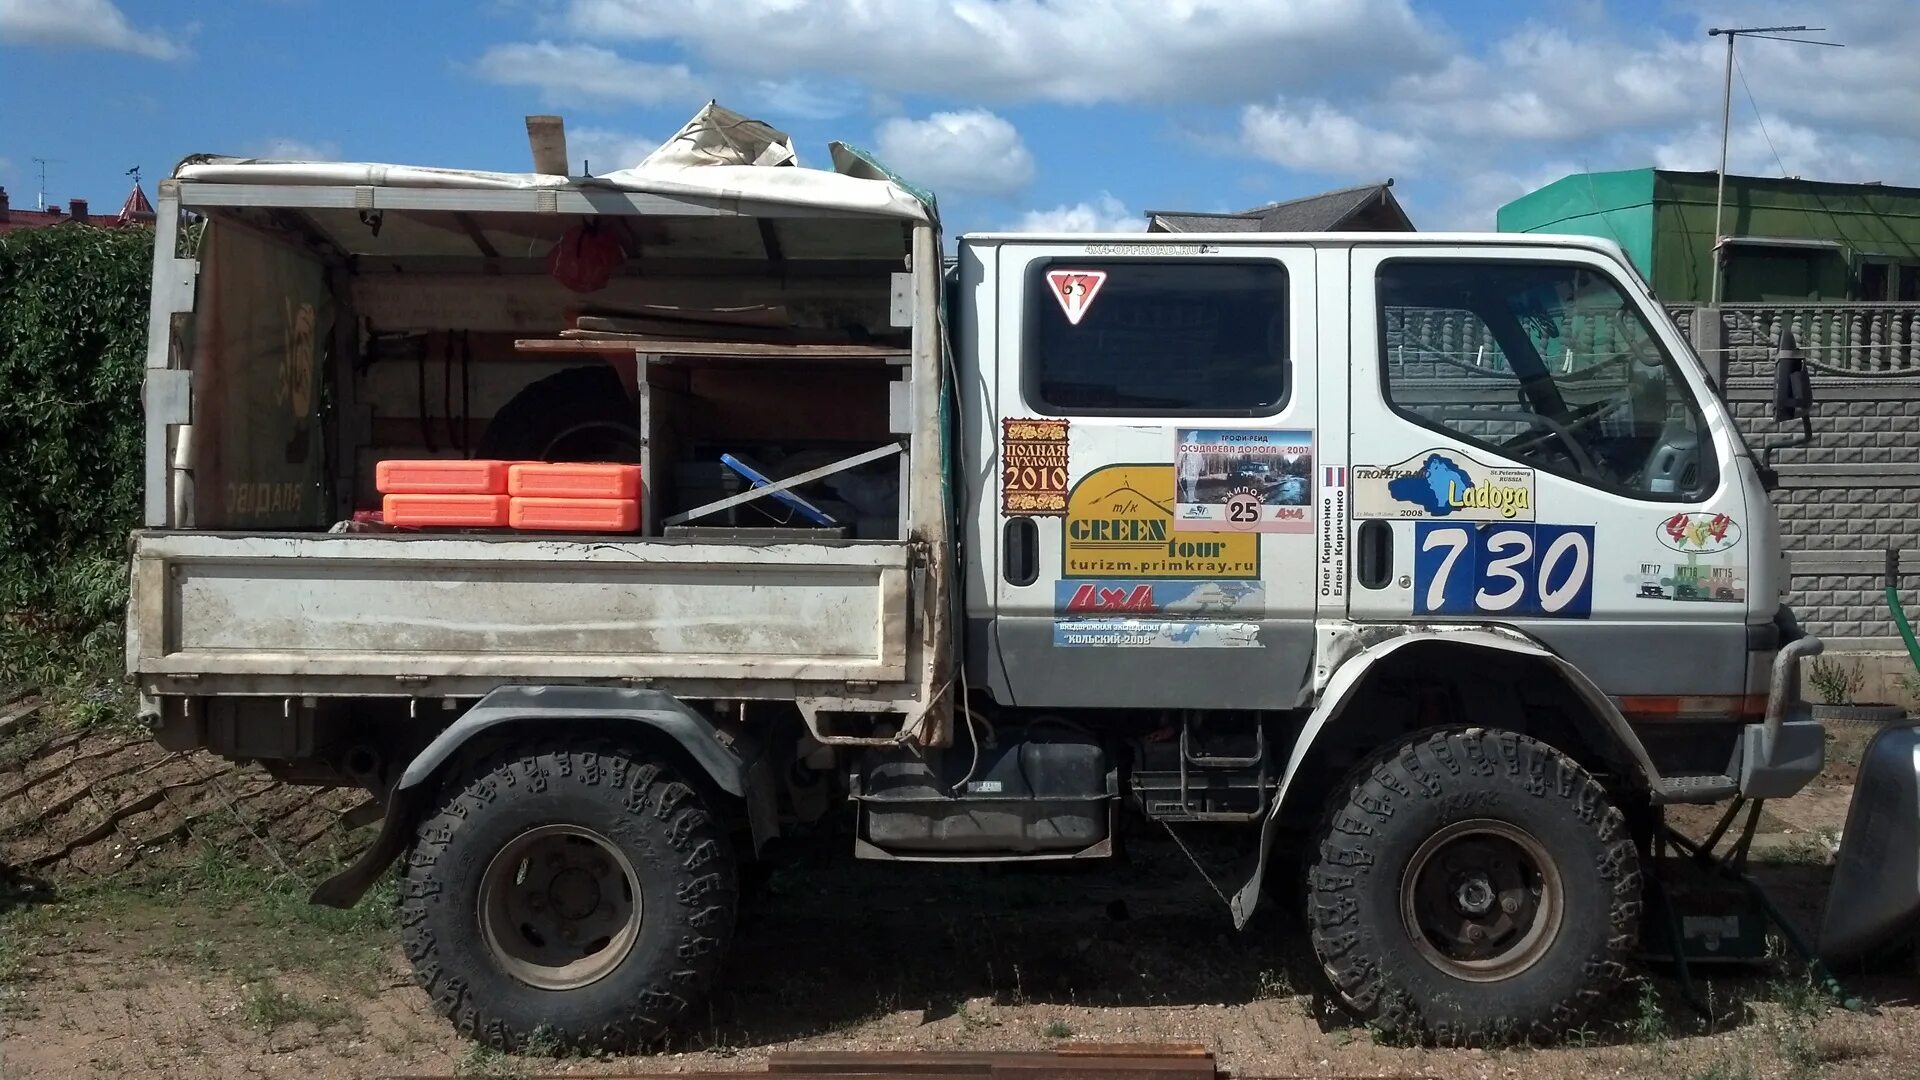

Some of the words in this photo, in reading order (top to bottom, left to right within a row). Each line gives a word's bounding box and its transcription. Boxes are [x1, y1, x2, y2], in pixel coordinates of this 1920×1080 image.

[1085, 244, 1199, 255] 4X4-OFFROAD.RU
[1062, 274, 1088, 297] 63
[1006, 444, 1066, 456] ПОЛНАЯ
[1180, 444, 1235, 454] ОСУДАРЕВА
[1238, 446, 1277, 454] ДОРОГА
[1287, 446, 1309, 454] 2007
[1006, 457, 1066, 468] ЧУХЛОМА
[1006, 466, 1067, 490] 2010
[1221, 486, 1266, 504] ЭКИПАЖ
[1449, 479, 1528, 518] Ladoga
[1230, 502, 1258, 522] 25
[1400, 509, 1423, 517] 2008
[1070, 519, 1167, 541] GREEN
[1321, 498, 1332, 564] Кириченко
[1334, 490, 1345, 556] Кириченко
[1168, 537, 1226, 558] tour
[1070, 560, 1254, 573] turizm.primkray.ru
[1423, 528, 1589, 612] 730
[1321, 567, 1331, 596] Олег
[1333, 559, 1343, 597] Елена
